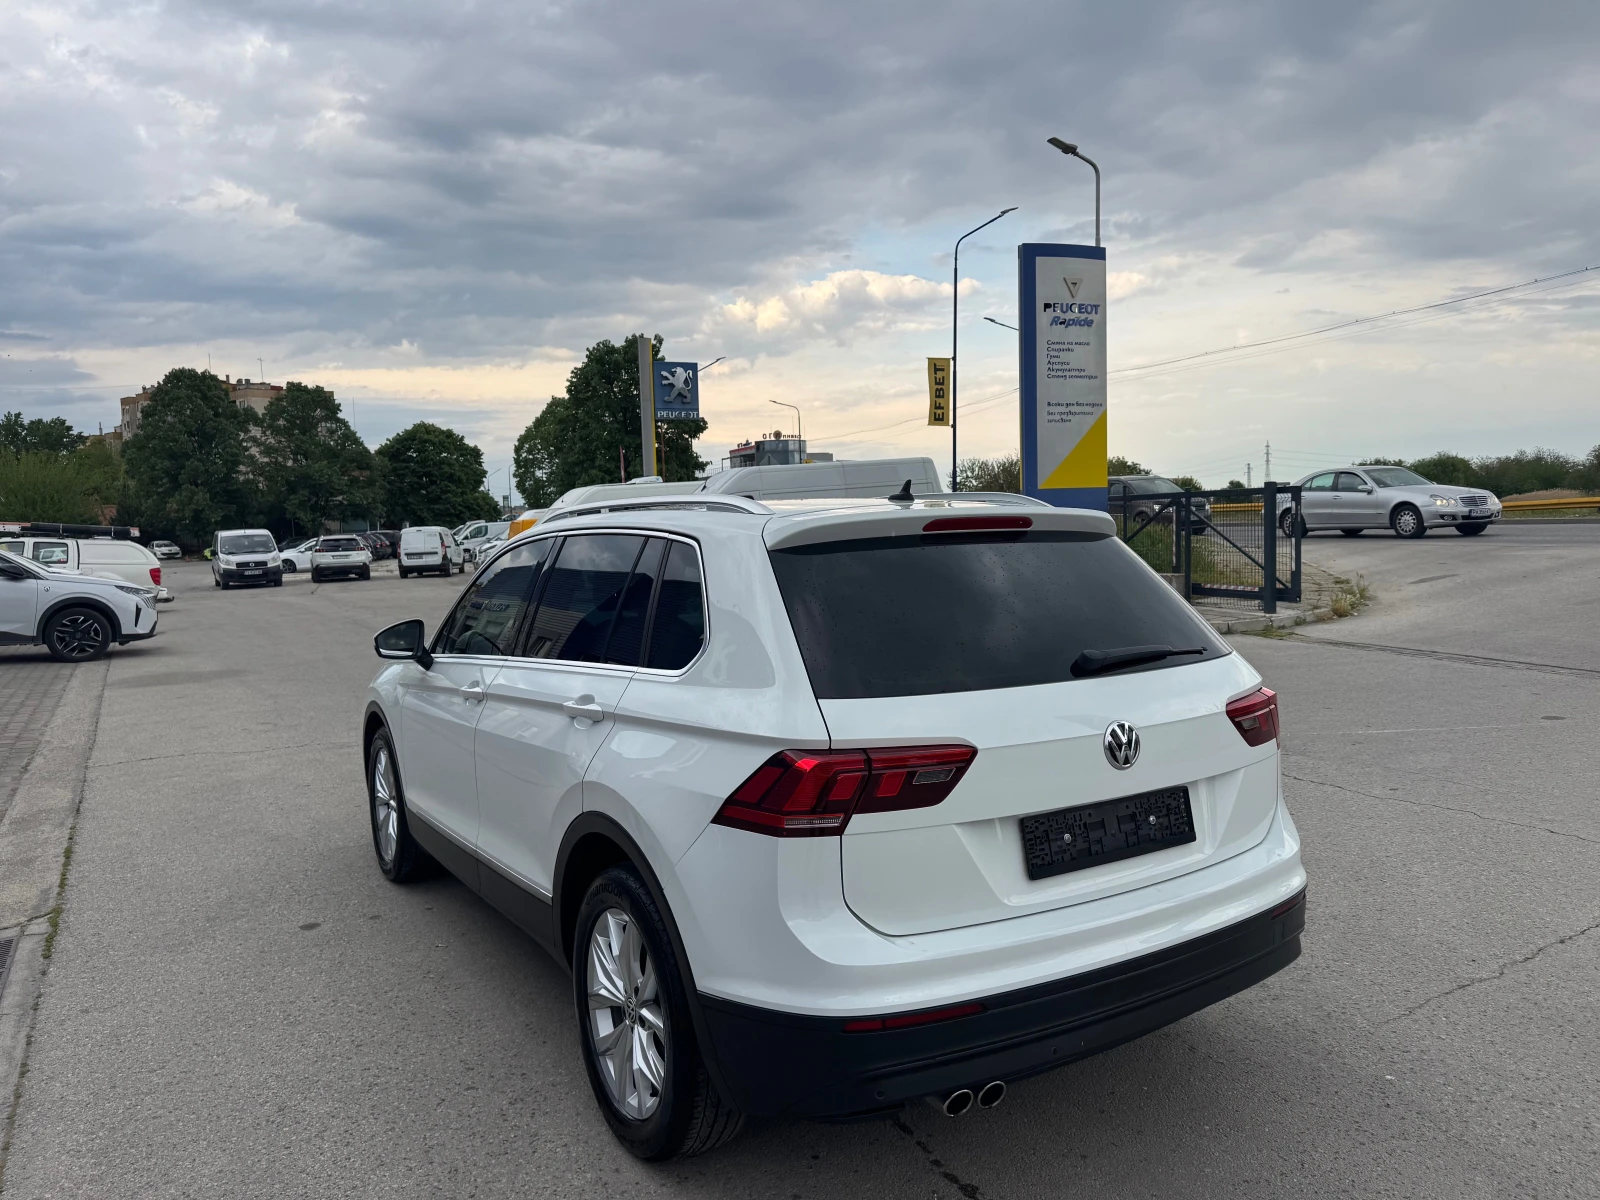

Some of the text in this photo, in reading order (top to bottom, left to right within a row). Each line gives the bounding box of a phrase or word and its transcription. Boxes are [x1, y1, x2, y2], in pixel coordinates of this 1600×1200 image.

[1043, 303, 1100, 315] PEUGEOT
[1050, 316, 1094, 328] Rapide
[934, 362, 945, 422] EFBET
[657, 410, 699, 419] PEUGEOT
